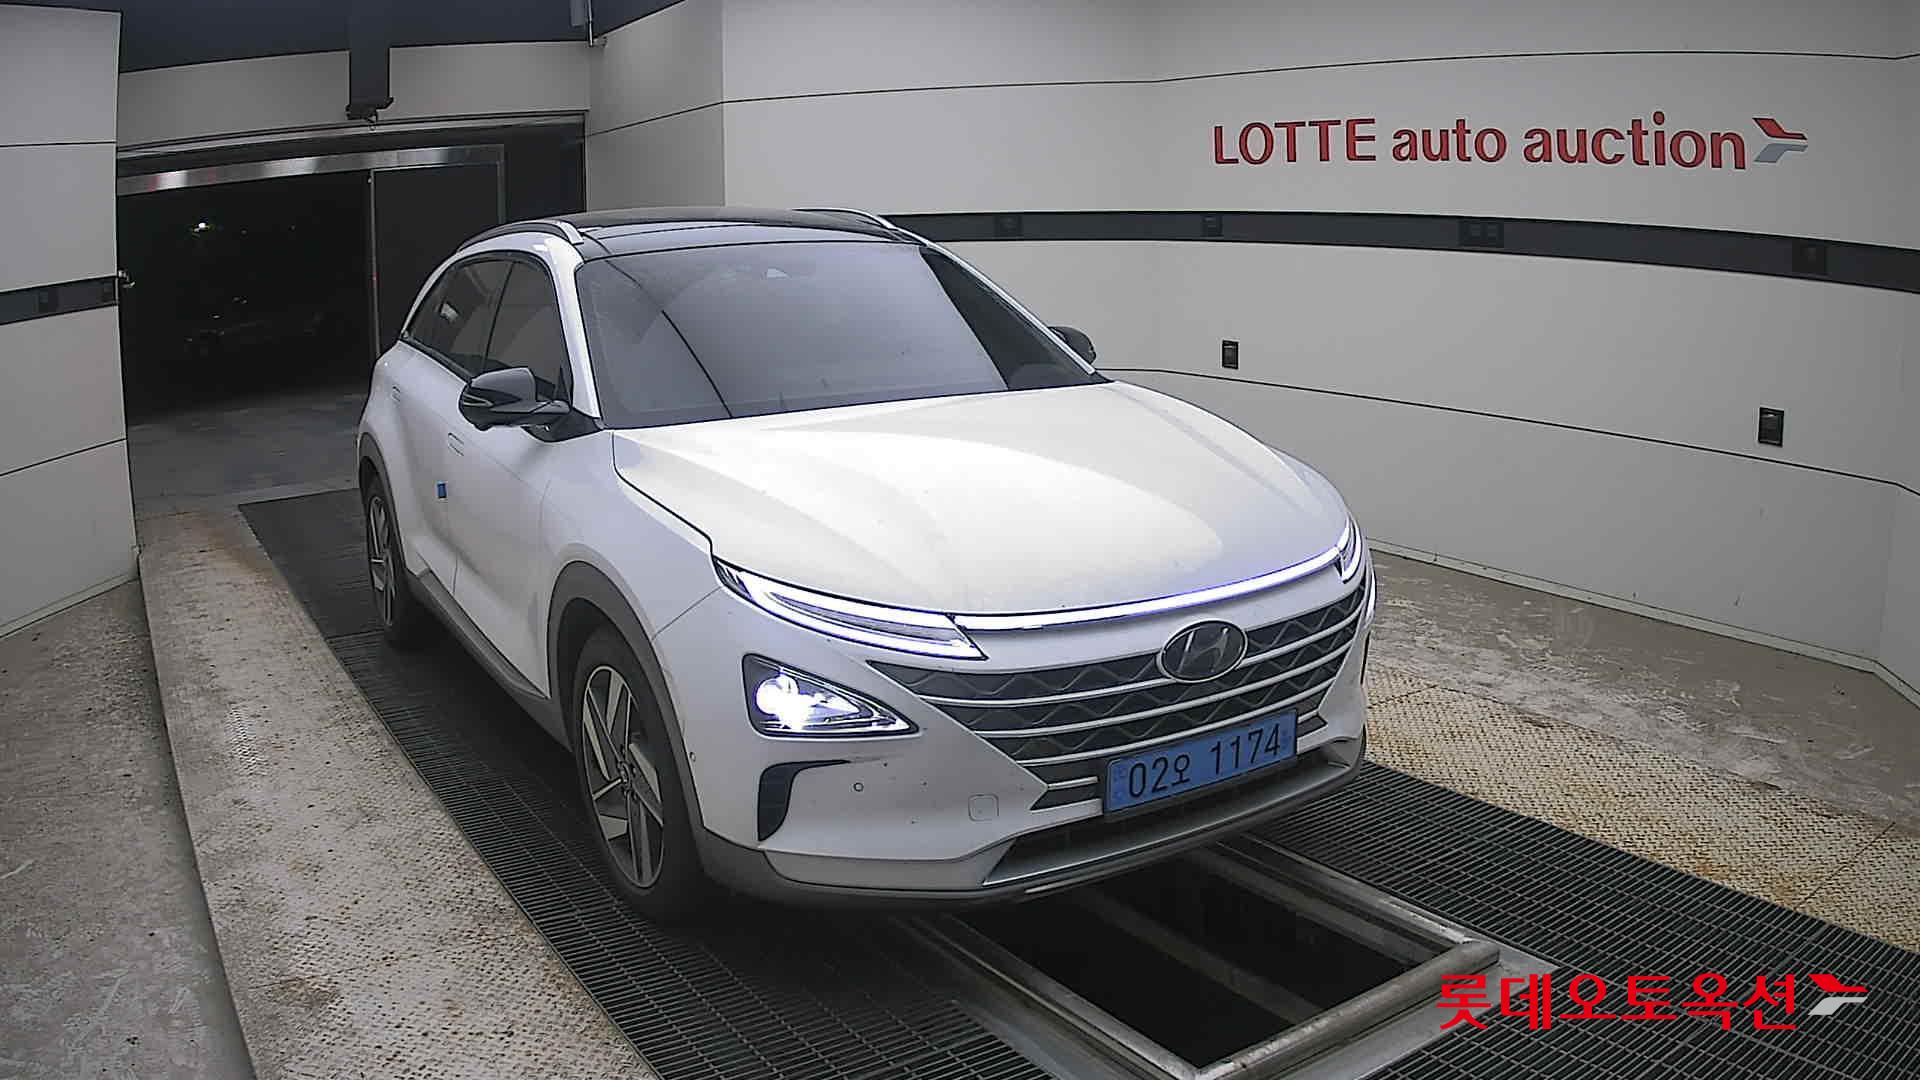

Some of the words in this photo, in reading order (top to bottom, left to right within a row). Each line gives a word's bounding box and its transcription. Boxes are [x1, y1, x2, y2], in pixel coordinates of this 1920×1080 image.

[1213, 117, 1376, 164] LOTTE
[1391, 118, 1508, 162] auto
[1522, 111, 1747, 170] auction
[1128, 753, 1191, 798] 02오
[1210, 722, 1281, 775] 1174
